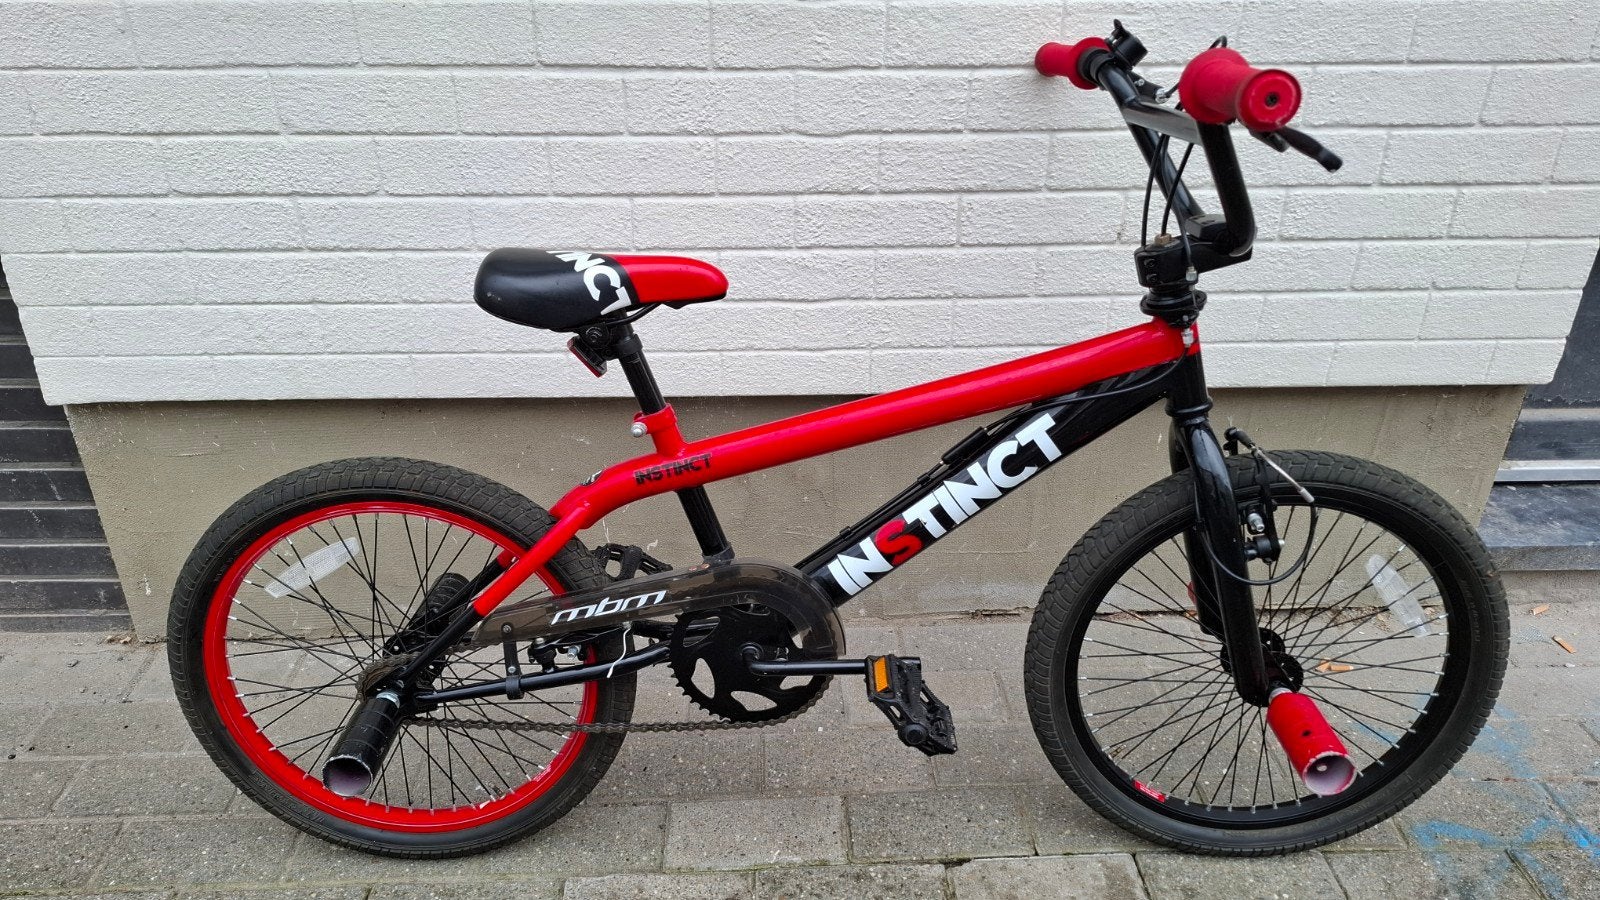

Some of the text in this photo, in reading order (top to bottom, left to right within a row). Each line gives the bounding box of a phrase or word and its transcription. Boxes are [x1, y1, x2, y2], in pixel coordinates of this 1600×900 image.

[634, 452, 712, 484] INSTINCT
[827, 412, 1062, 596] INSTINCT
[551, 590, 666, 625] mbm
